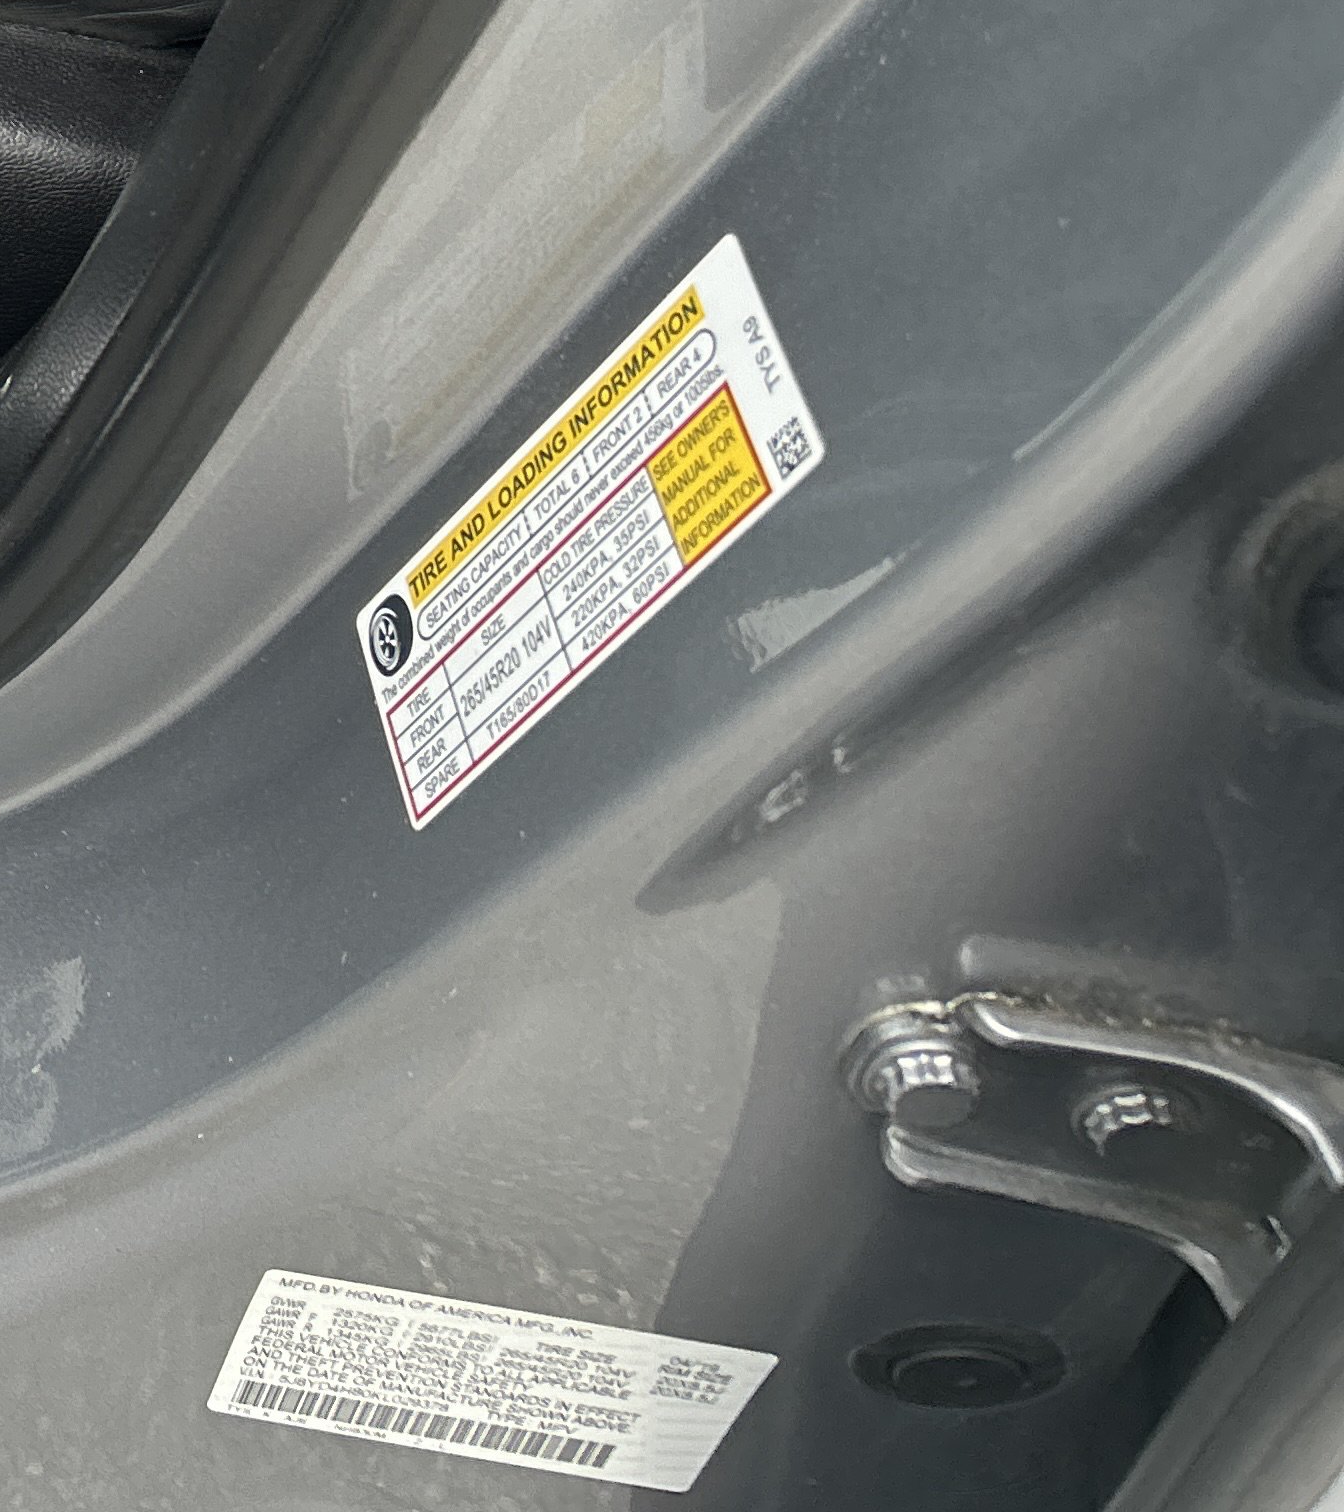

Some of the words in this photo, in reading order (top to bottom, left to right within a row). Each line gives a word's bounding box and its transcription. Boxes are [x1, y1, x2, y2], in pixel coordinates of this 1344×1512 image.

[741, 312, 764, 350] A9
[754, 343, 783, 394] TYS
[409, 549, 447, 600] TIRE
[447, 510, 486, 561] AND
[487, 426, 568, 522] LOADING
[567, 294, 699, 439] INFORMATION
[652, 449, 677, 482] SEE
[675, 398, 730, 460] OWNER'S
[425, 575, 470, 630] SEATING
[469, 522, 523, 586] CAPACITY
[533, 476, 570, 522] TOTAL
[570, 467, 580, 486] 6
[592, 414, 633, 464] FRONT
[632, 405, 643, 424] 2
[656, 356, 692, 399] REAR
[690, 346, 701, 364] 4
[661, 450, 710, 508] MANUAL
[708, 426, 735, 461] FOR
[670, 456, 739, 532] ADDITIONAL
[680, 470, 761, 557] INFORMATION
[381, 679, 398, 705] The
[396, 643, 435, 692] combined
[433, 617, 463, 657] weight
[460, 609, 470, 627] of
[469, 567, 513, 621] occupants
[511, 550, 529, 577] and
[529, 529, 554, 563] cargo
[552, 496, 584, 536] should
[583, 474, 610, 507] never
[608, 439, 643, 482] exceed
[671, 401, 683, 419] or
[542, 549, 572, 587] COLD
[570, 527, 595, 560] TIRE
[593, 475, 649, 538] PRESSURE
[612, 508, 650, 553] 35PSI
[622, 534, 660, 580] 32PSI
[631, 560, 670, 606] 60PSI
[480, 612, 506, 647] SIZE
[459, 644, 522, 719] 265/45R20
[520, 614, 554, 659] 104V
[406, 685, 431, 719] TIRE
[409, 703, 446, 749] FRONT
[416, 735, 446, 774] REAR
[423, 755, 460, 800] SPARE
[344, 1289, 407, 1307] HONDA
[407, 1300, 433, 1311] OF
[250, 1335, 325, 1355] FEDERAL
[256, 1325, 294, 1340] THIS
[241, 1356, 268, 1368] ON
[269, 1361, 304, 1374] THE
[306, 1367, 350, 1383] DATE
[351, 1375, 377, 1387] OF
[246, 1345, 284, 1359] AND
[287, 1352, 339, 1369] THEFT
[340, 1362, 449, 1389] PREVENTION
[574, 1404, 642, 1423] EFFECT
